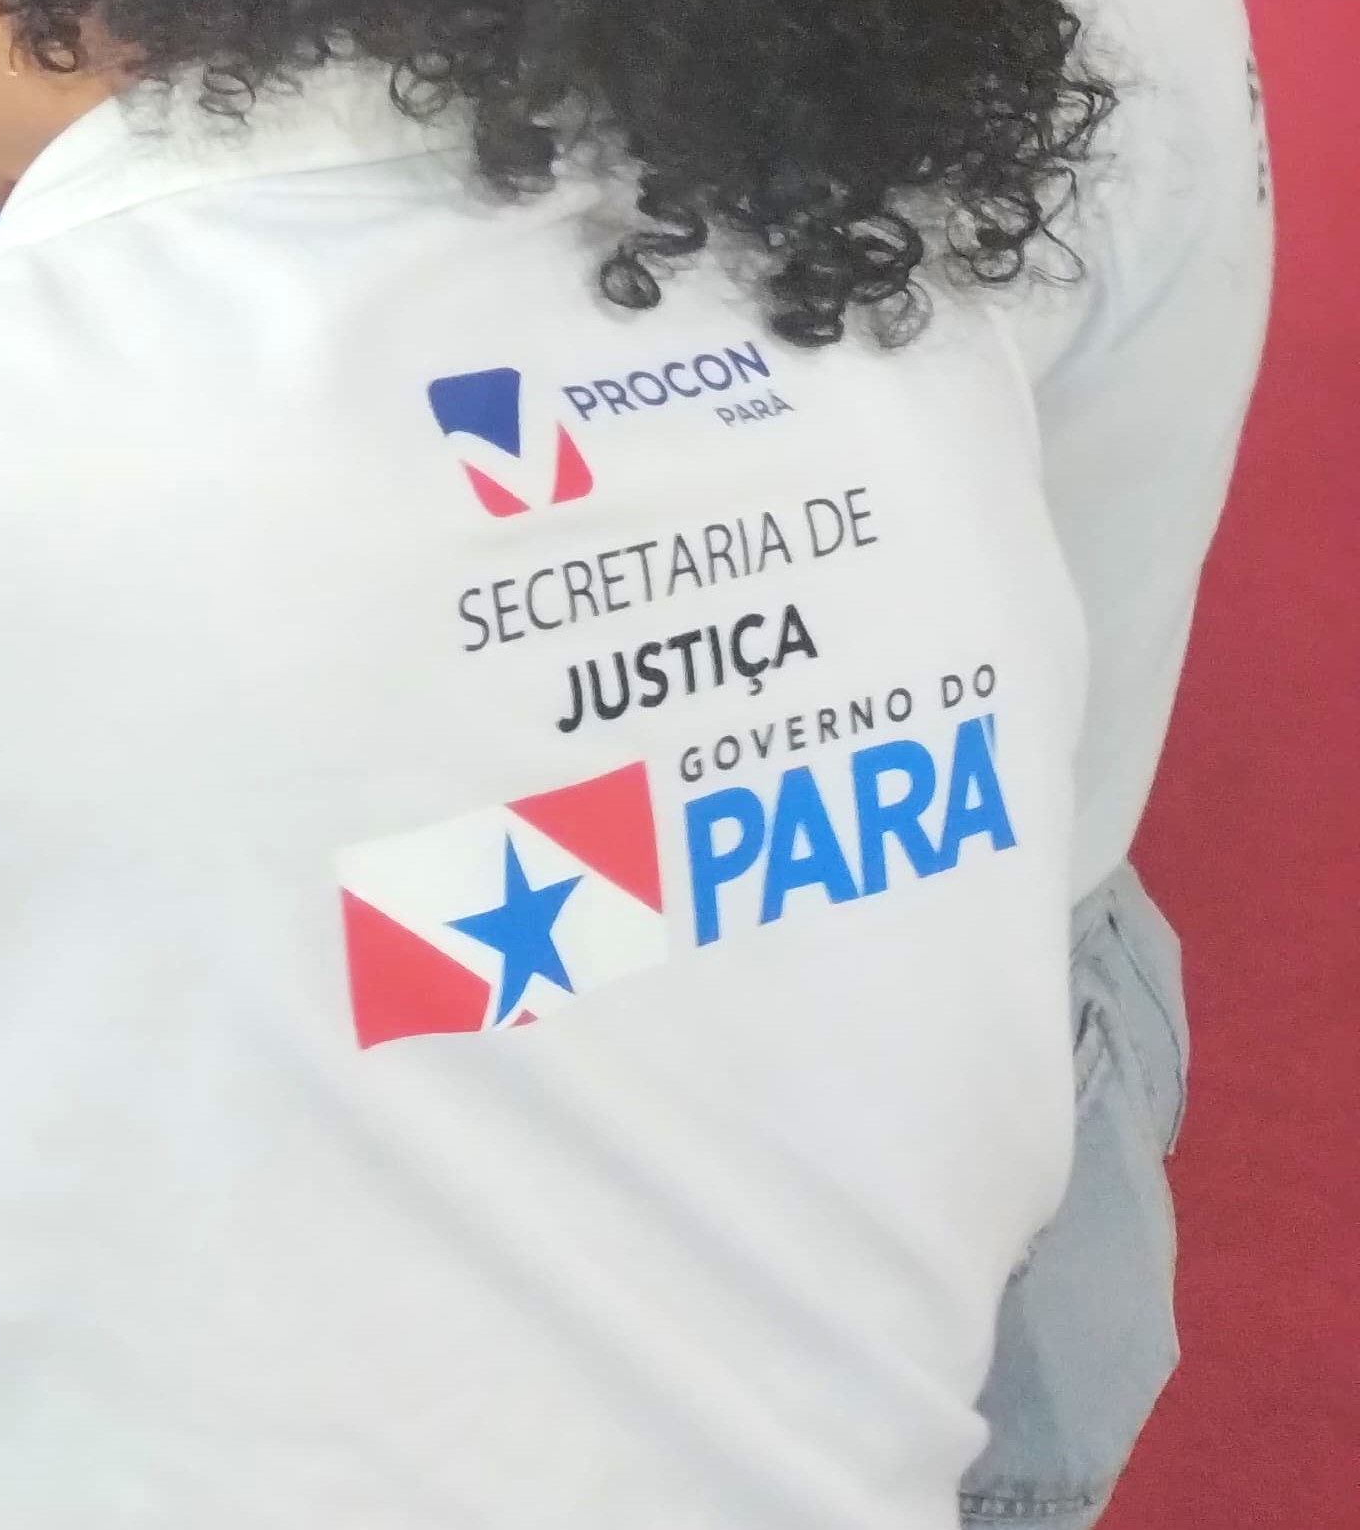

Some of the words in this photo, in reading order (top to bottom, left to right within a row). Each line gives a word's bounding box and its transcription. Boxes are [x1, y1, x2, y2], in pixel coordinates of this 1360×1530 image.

[562, 340, 771, 421] PROCON
[458, 511, 792, 652] SECRETARIA
[805, 487, 878, 558] DE
[556, 604, 818, 734] JUSTIÇA
[679, 687, 913, 783] GOVERNO
[941, 664, 997, 709] DO
